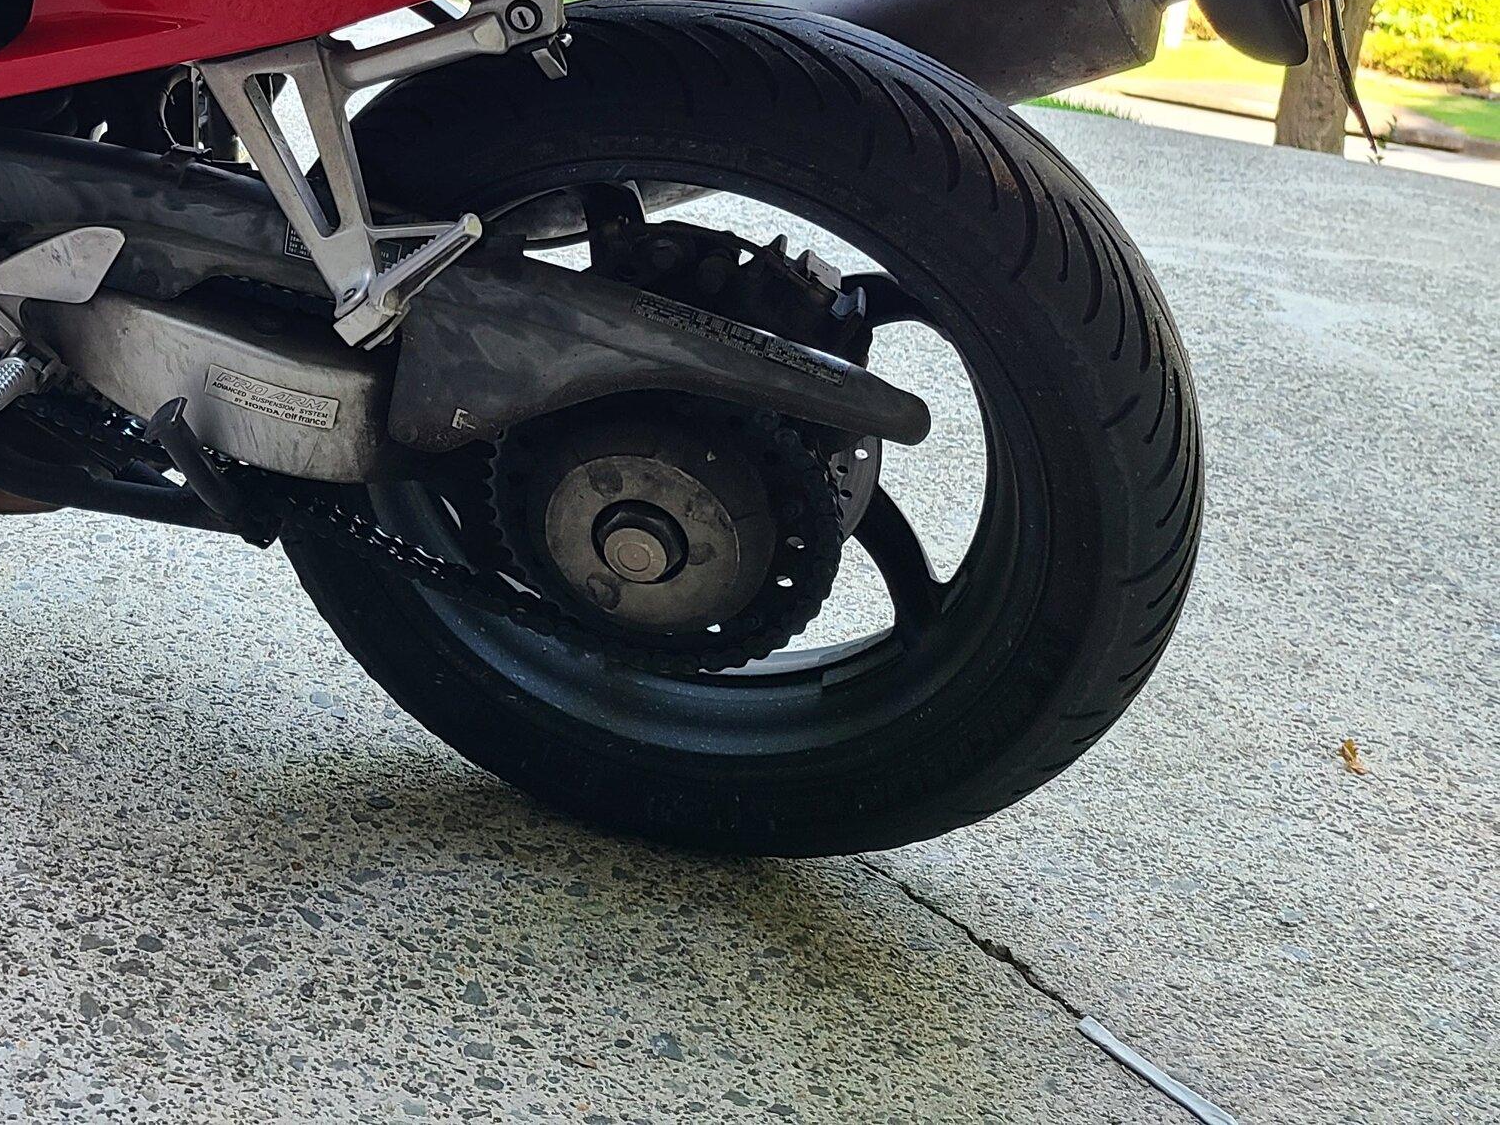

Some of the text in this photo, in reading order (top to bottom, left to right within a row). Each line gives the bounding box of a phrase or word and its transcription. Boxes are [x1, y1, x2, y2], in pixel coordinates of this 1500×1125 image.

[212, 381, 329, 419] ADVANCED SUSPENSION SYSTEM
[216, 372, 329, 411] PRO ARM
